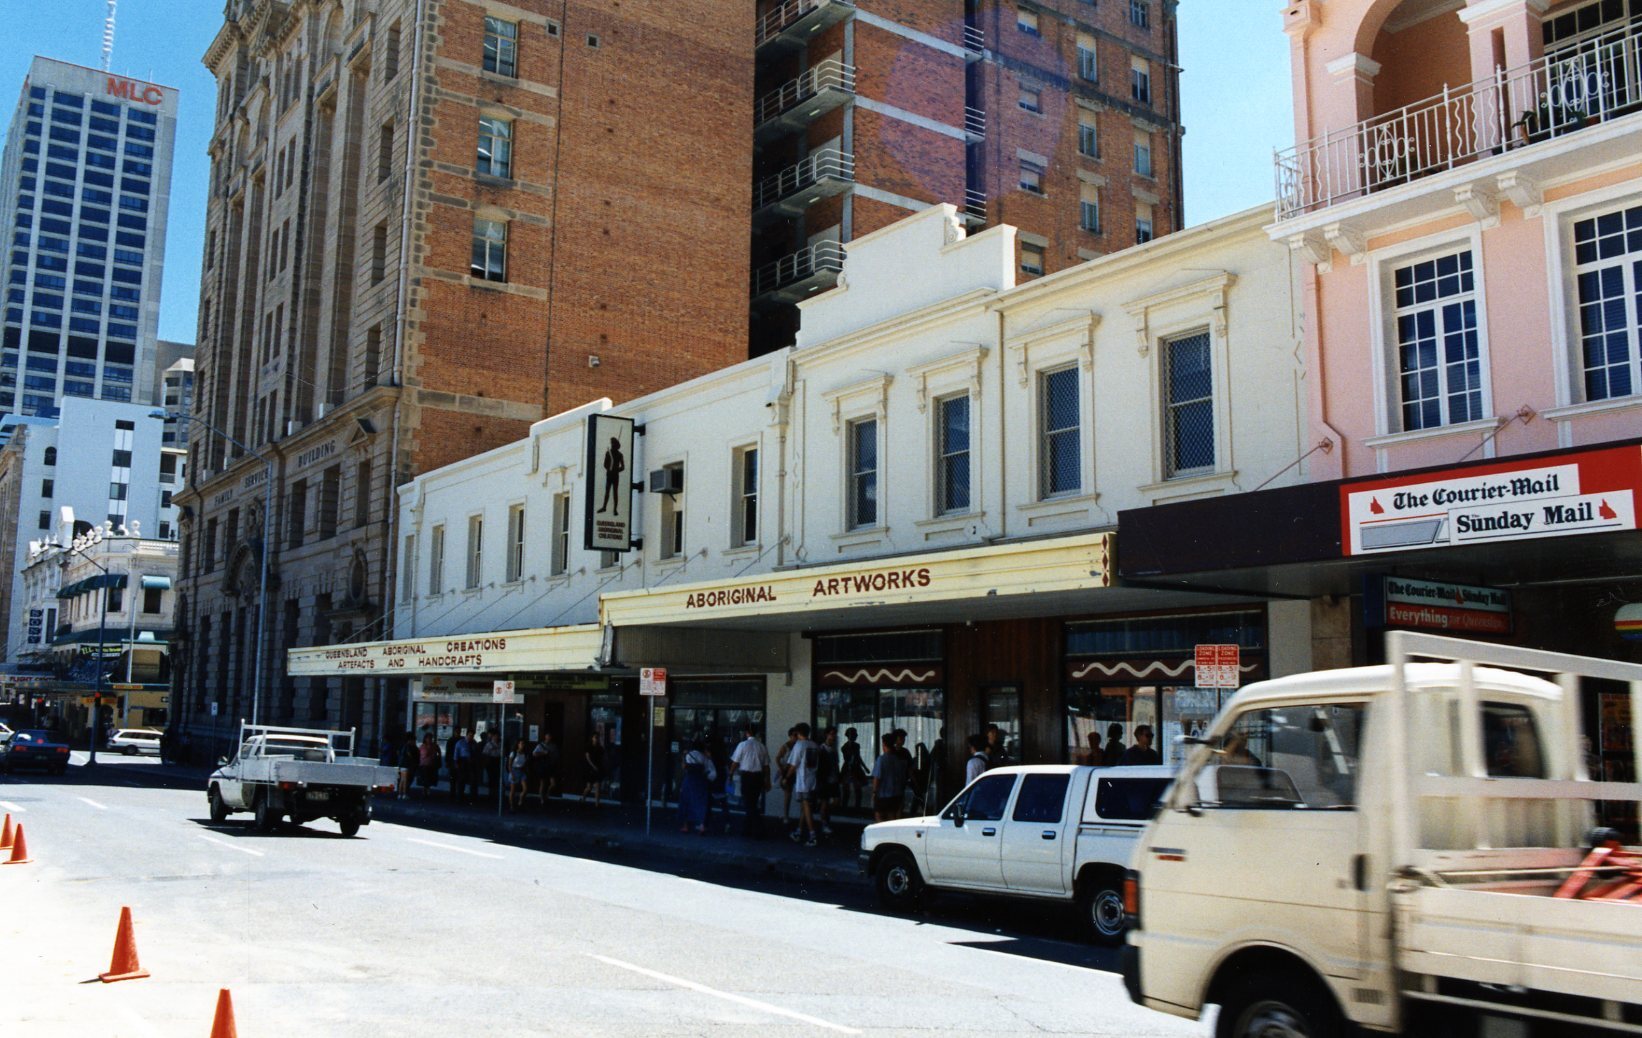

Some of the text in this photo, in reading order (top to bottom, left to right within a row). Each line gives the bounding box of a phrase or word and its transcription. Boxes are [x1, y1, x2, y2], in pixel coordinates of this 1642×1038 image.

[106, 77, 163, 105] MLC
[298, 440, 336, 467] BUILDING
[1393, 474, 1560, 510] The Courier-Mail
[1456, 502, 1594, 534] Sunday Mail
[686, 568, 931, 608] ABORIGINAL ARTWORKS
[1389, 606, 1448, 628] Everything
[325, 638, 506, 659] QUEENSLAND ABORIGINAL CREATIONS
[338, 654, 482, 669] ARTEFACTS AND HANDCRAFTS
